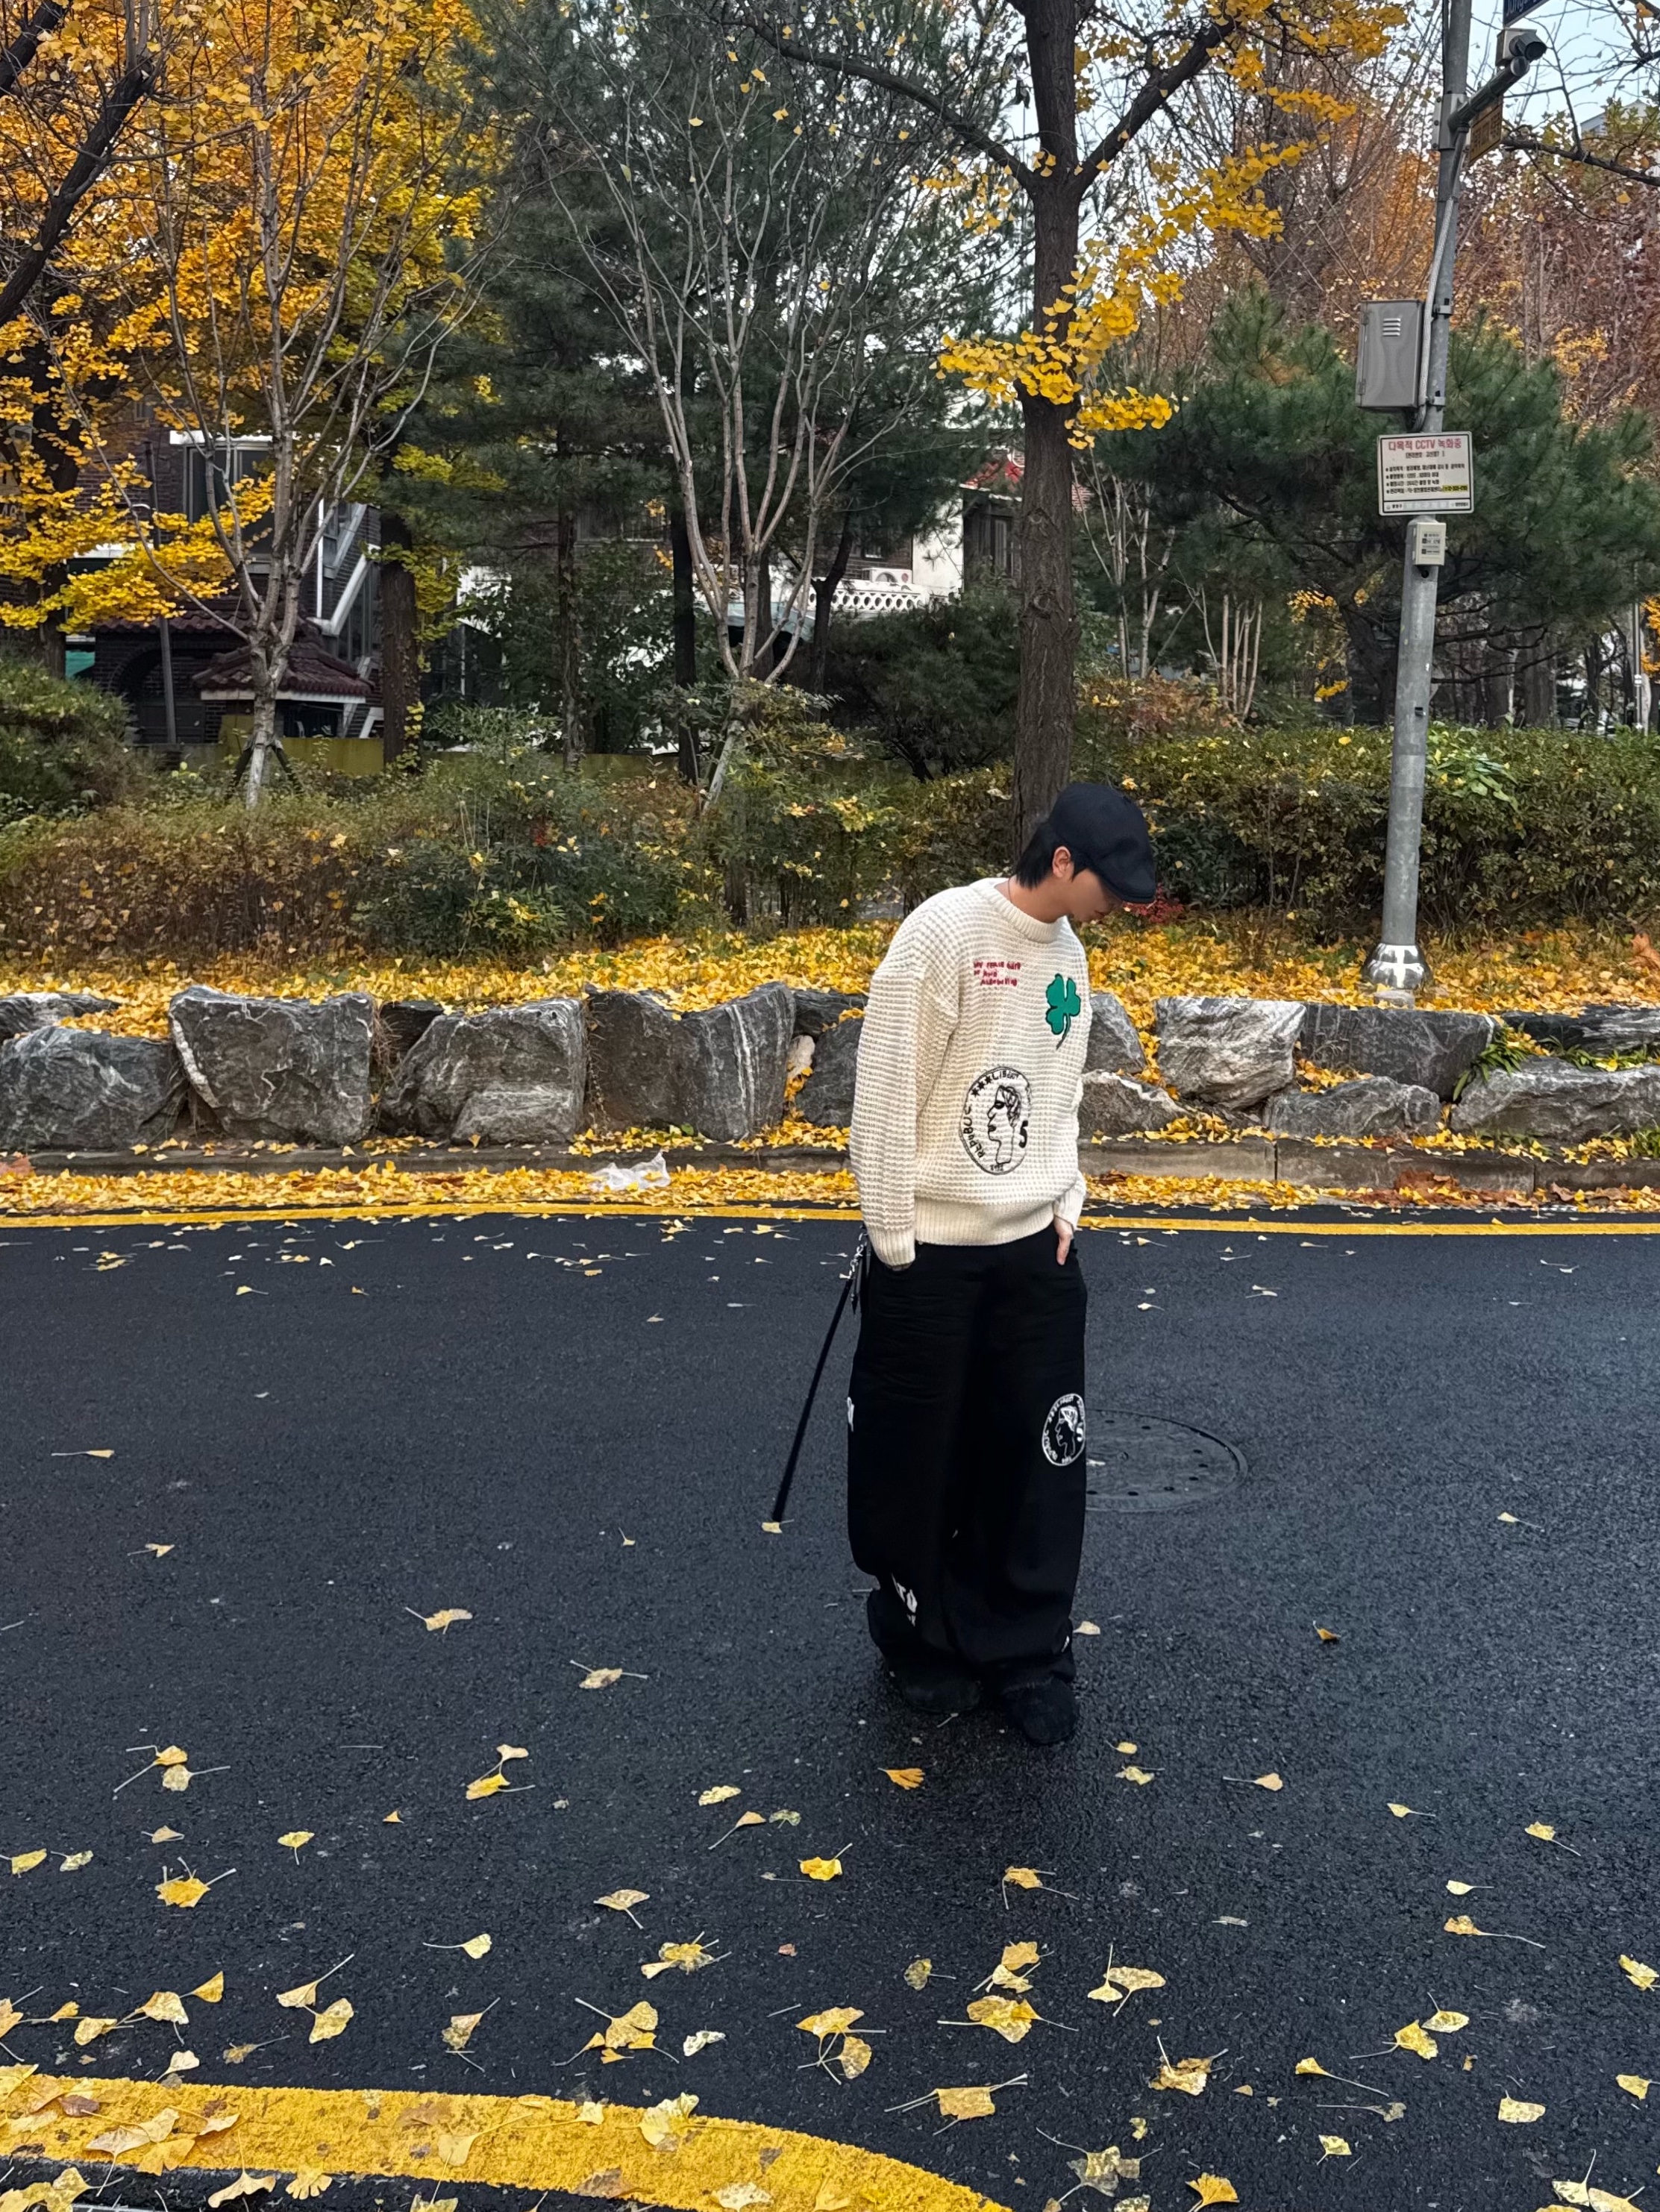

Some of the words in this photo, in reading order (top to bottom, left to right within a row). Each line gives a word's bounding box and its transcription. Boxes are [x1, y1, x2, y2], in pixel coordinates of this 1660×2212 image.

[1415, 439, 1435, 450] CCTV
[1438, 438, 1462, 449] 녹화중
[1018, 1120, 1029, 1148] 5
